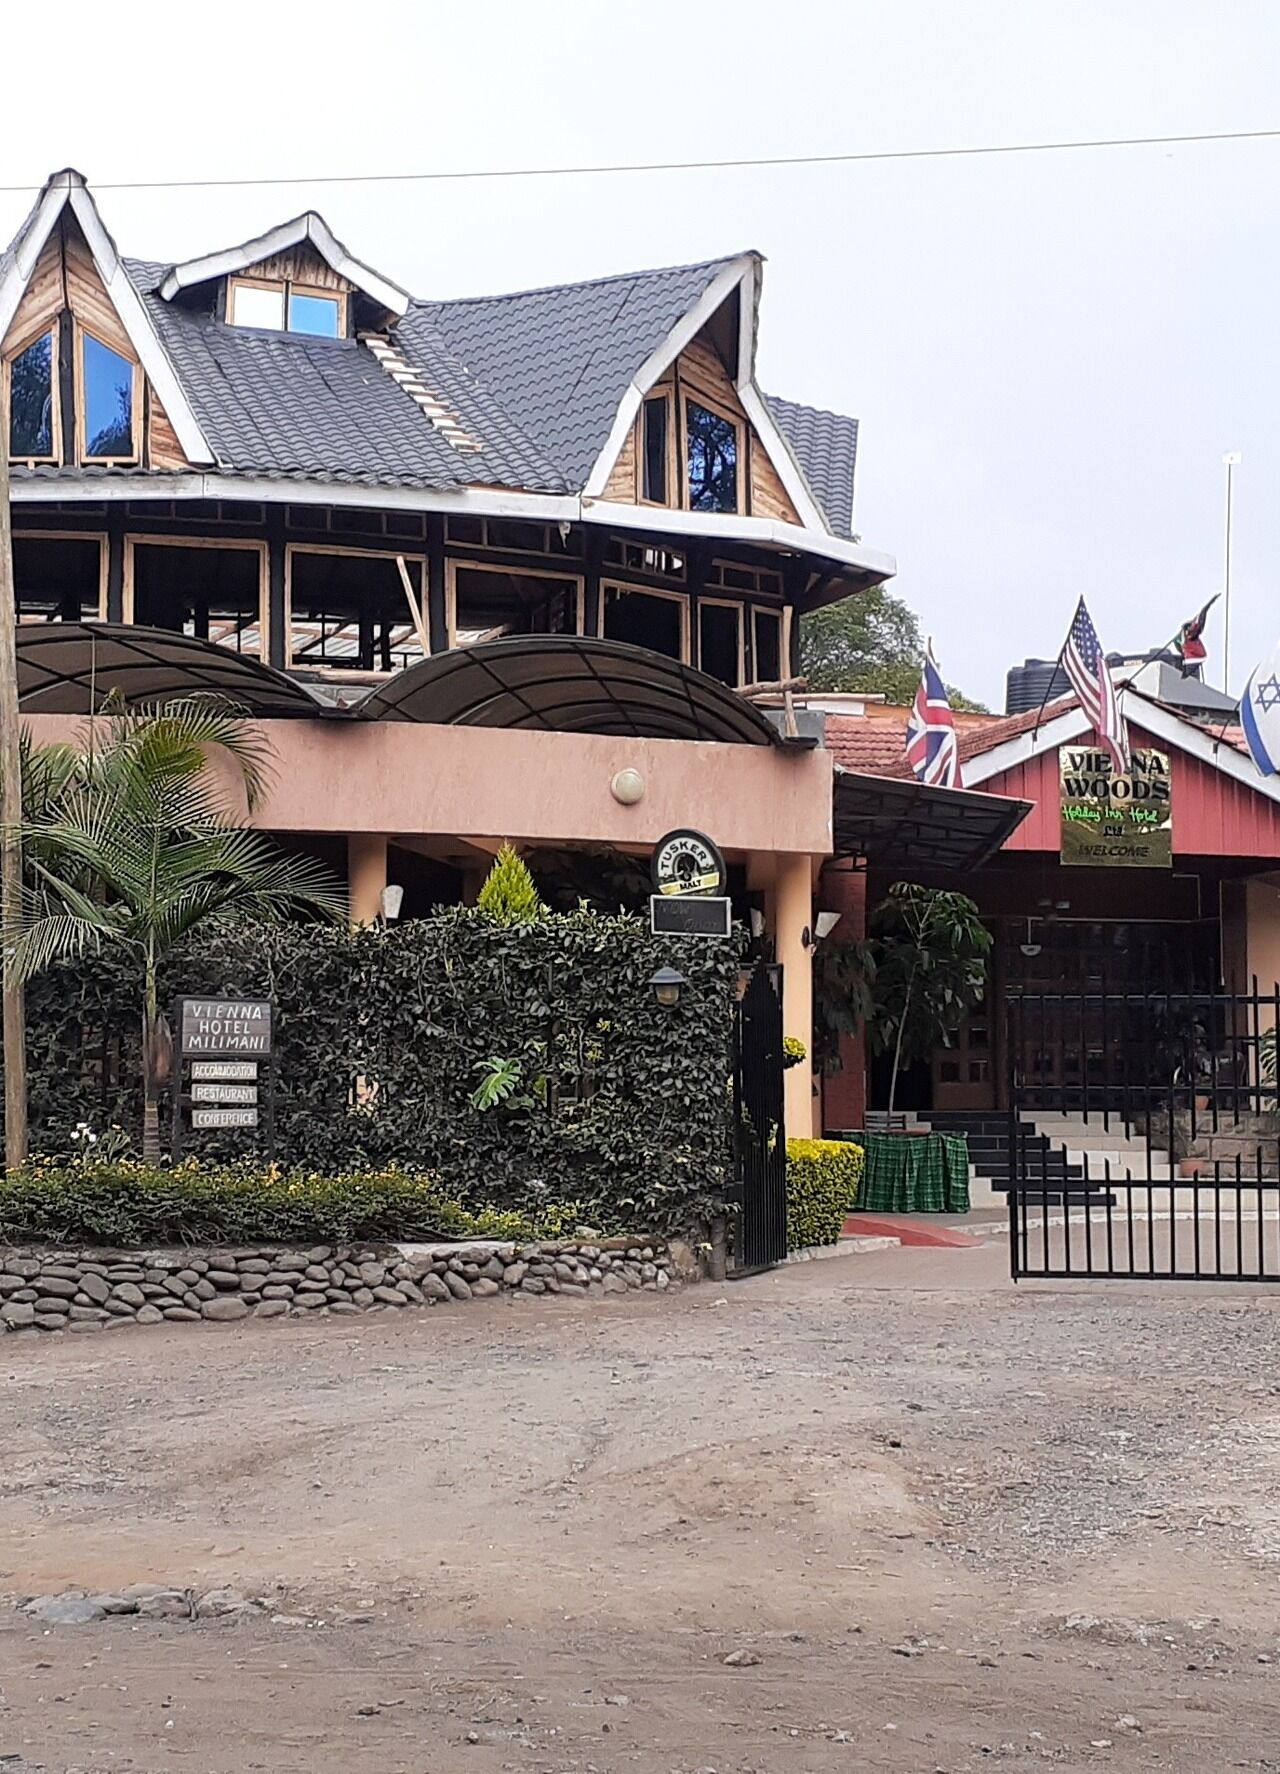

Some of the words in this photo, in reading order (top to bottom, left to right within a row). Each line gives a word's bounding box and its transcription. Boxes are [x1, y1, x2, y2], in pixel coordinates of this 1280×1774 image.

[1067, 752, 1165, 775] VIENA
[1063, 778, 1170, 800] WOODS
[1062, 805, 1101, 823] Holiday
[1105, 805, 1123, 820] Inn
[1129, 806, 1158, 823] Hotel
[661, 841, 707, 871] TUSKER
[1077, 844, 1150, 858] WELCOME
[679, 879, 702, 891] MALT
[192, 1005, 262, 1020] VIENNA
[200, 1020, 251, 1035] HOTEL
[188, 1035, 264, 1049] MILIMANI
[194, 1064, 257, 1077] ACCOMMODATION
[196, 1087, 254, 1100] RESTAURANT
[198, 1112, 254, 1125] CONFERENCE
